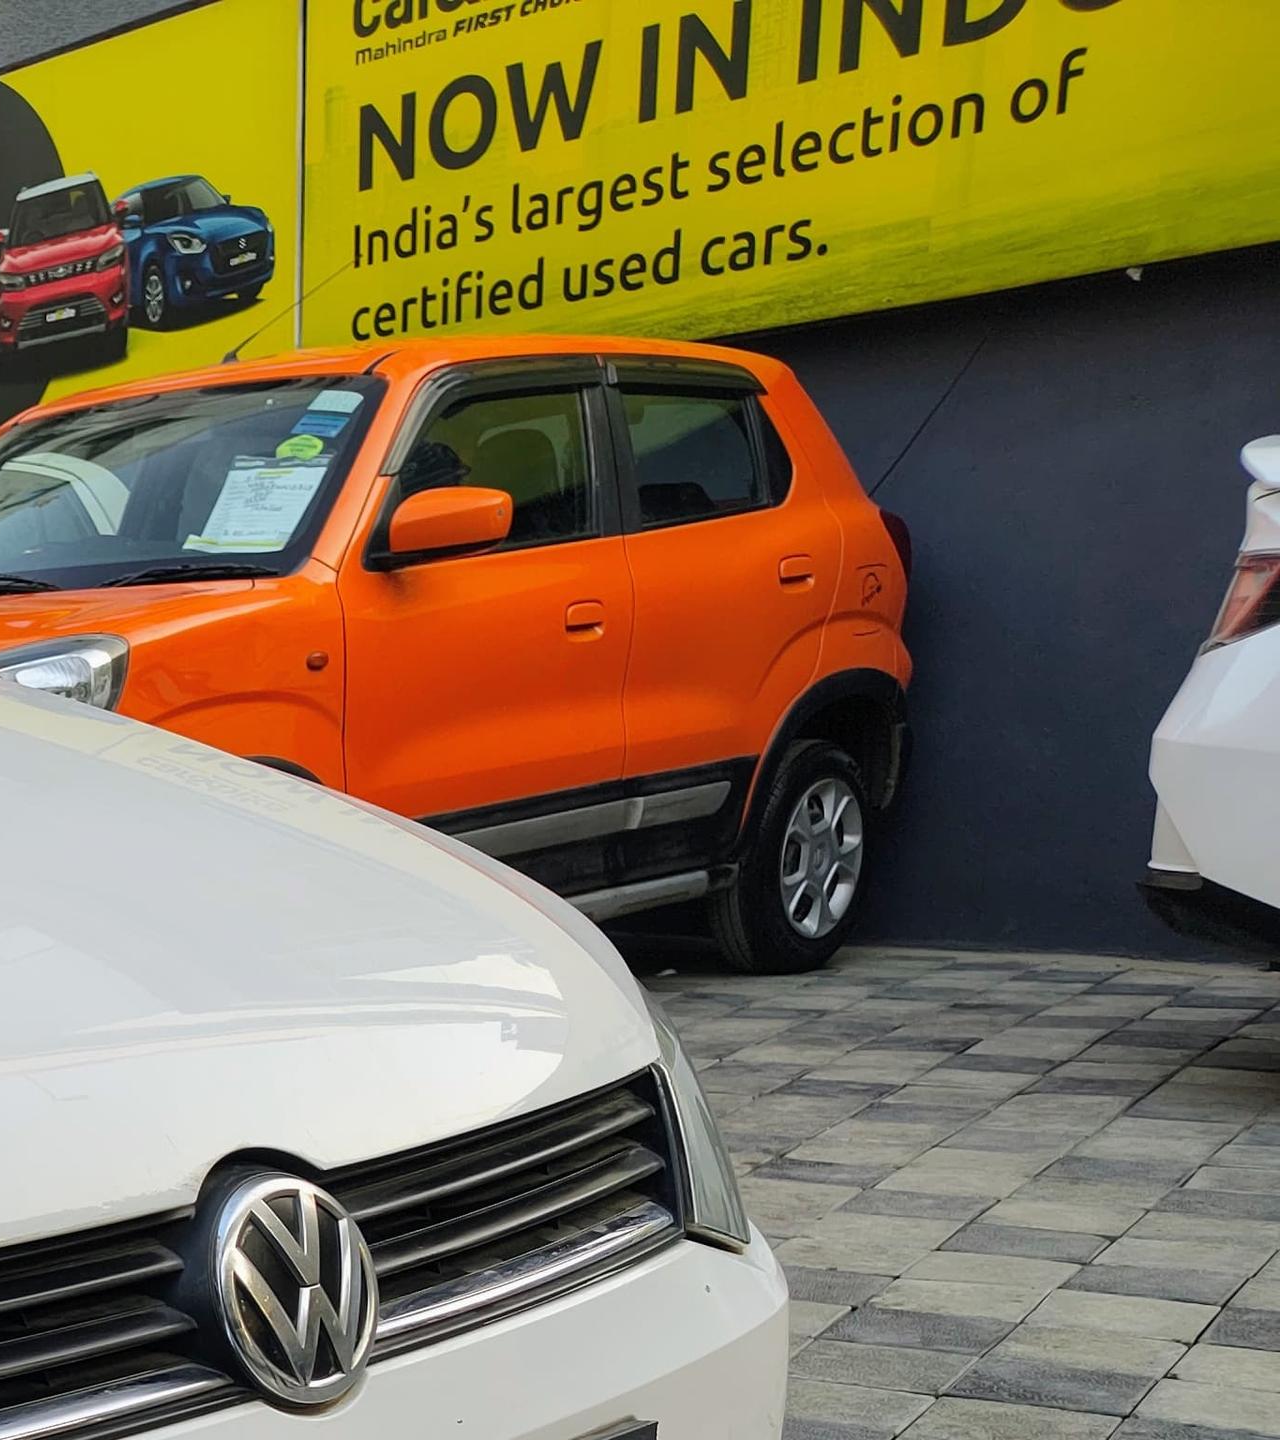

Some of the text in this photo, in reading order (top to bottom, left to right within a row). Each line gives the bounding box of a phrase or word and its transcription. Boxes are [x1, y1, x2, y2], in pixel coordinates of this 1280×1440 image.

[355, 27, 448, 66] Mahindra
[452, 2, 517, 38] FIRST
[358, 39, 603, 192] NOW
[638, 0, 752, 123] IN
[353, 46, 1089, 268] India's largest selection of
[351, 217, 829, 342] certified used cars.
